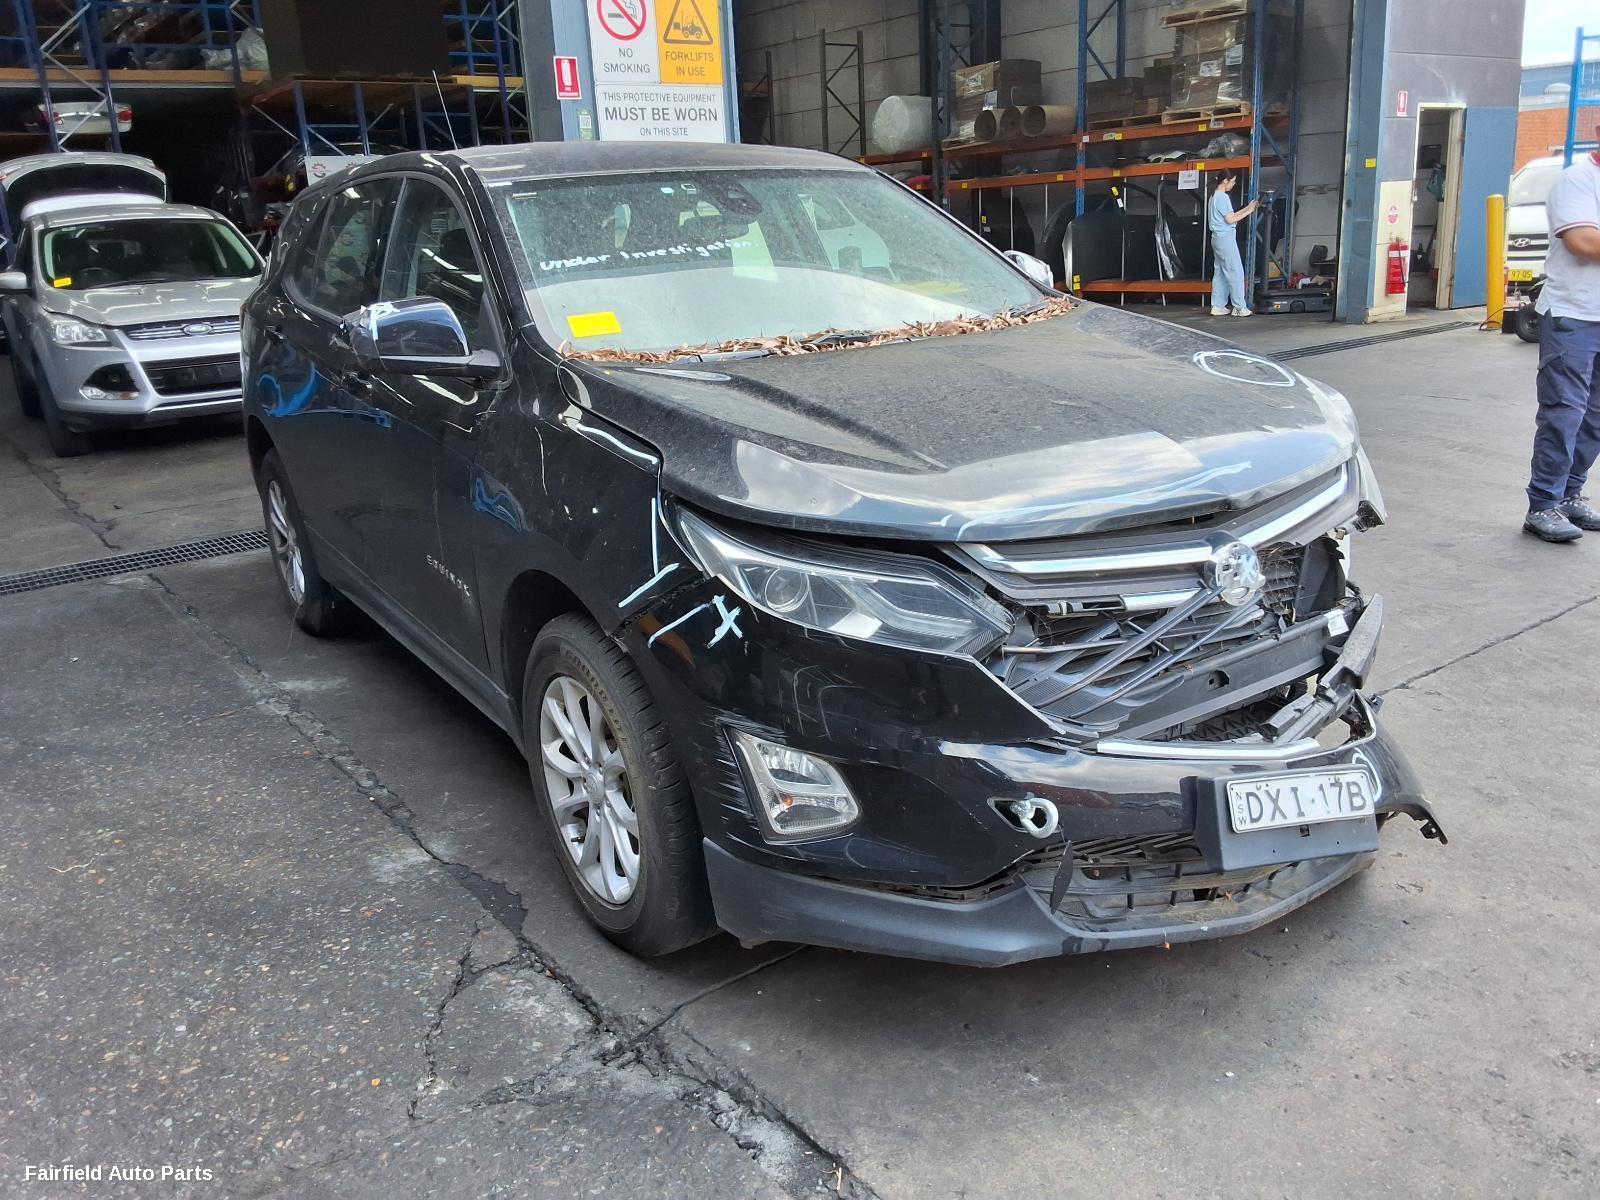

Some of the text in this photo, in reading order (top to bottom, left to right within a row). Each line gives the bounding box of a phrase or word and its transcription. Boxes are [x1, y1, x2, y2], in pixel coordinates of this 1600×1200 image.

[618, 47, 634, 58] NO
[665, 51, 714, 62] FORKLIFTS
[603, 63, 651, 73] SMOKING
[676, 66, 706, 76] IN USE
[603, 92, 716, 103] THIS PROTECTIVE EQUIPMENT
[605, 107, 718, 121] MUST BE WORN
[639, 127, 689, 137] ON THIS SITE
